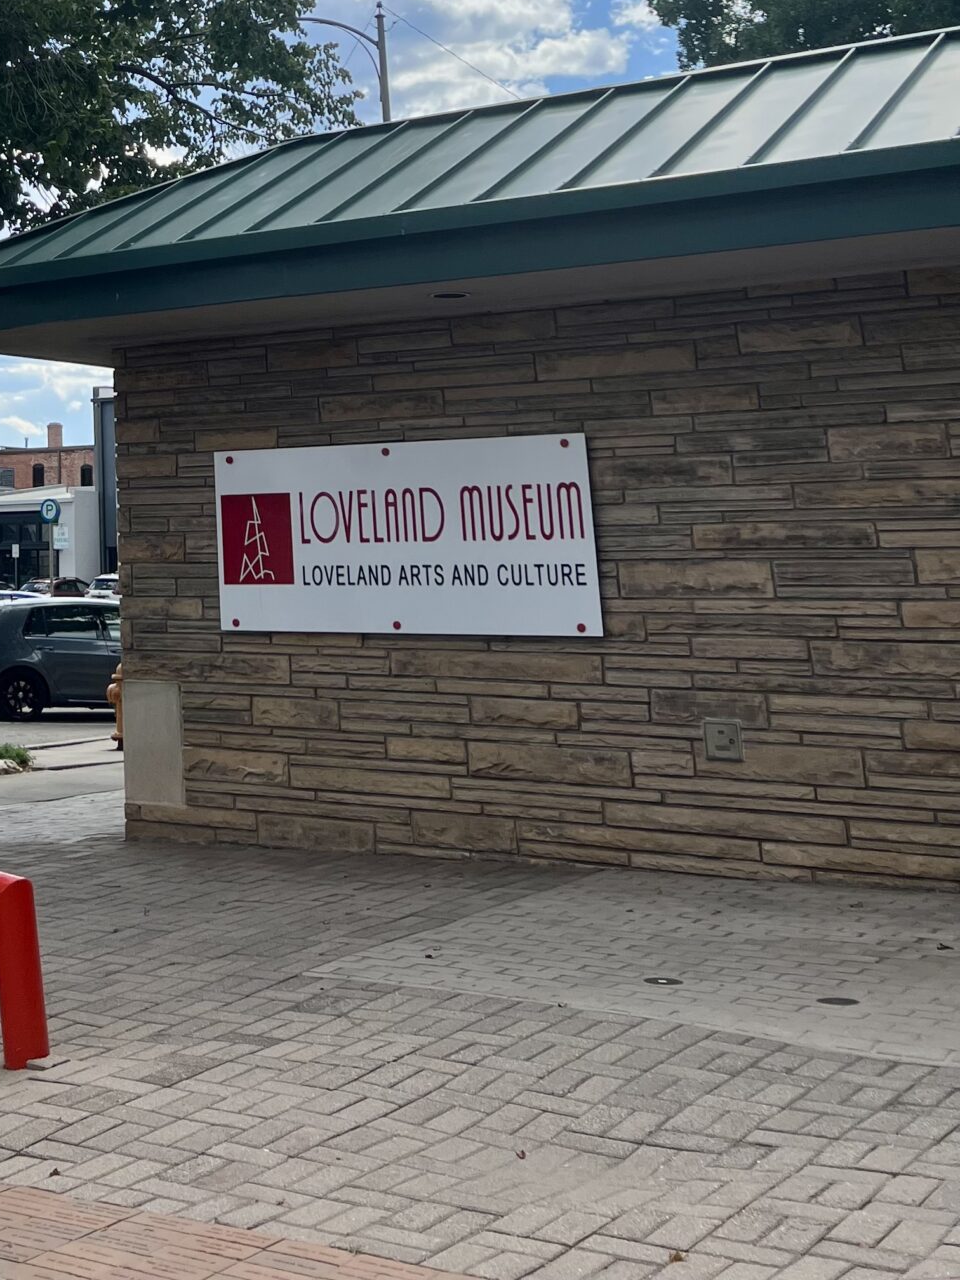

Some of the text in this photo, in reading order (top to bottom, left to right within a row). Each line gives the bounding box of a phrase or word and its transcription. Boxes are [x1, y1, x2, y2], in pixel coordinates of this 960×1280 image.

[299, 481, 585, 544] LOVELAND MUSEUM
[302, 563, 587, 586] LOVELAND ARTS AND CULTURE
